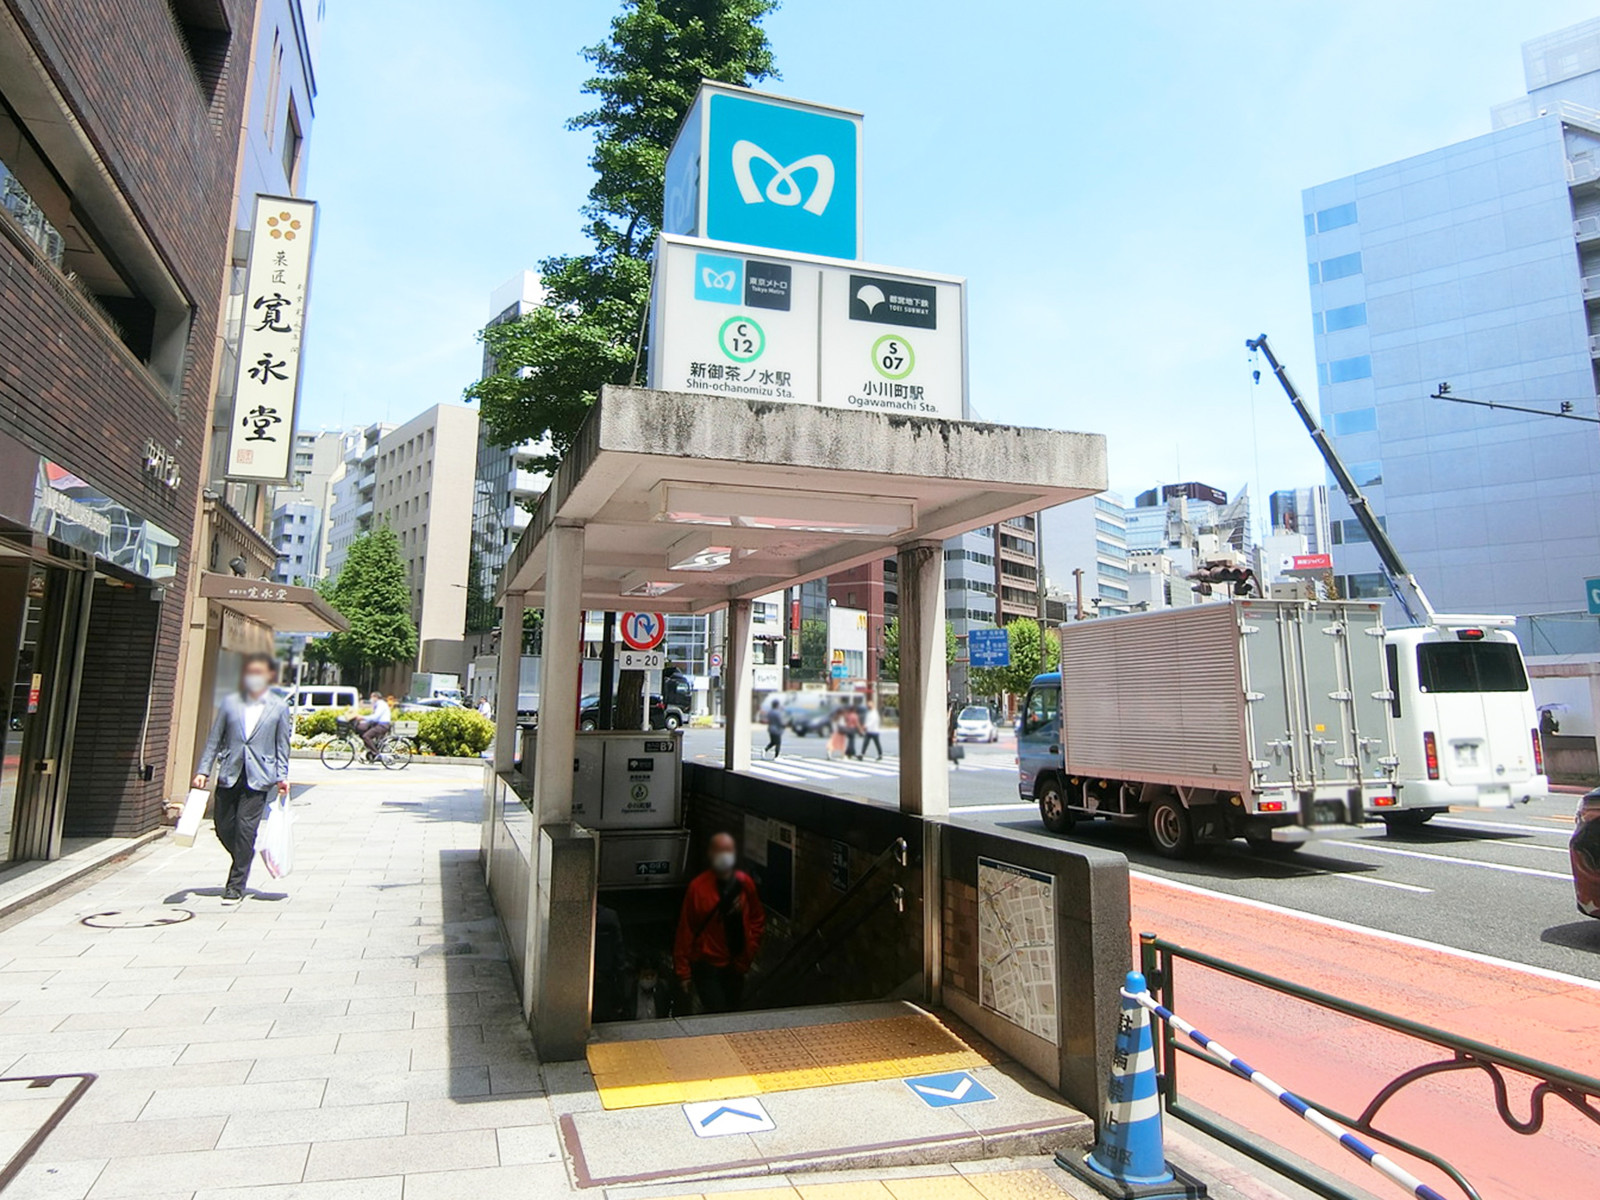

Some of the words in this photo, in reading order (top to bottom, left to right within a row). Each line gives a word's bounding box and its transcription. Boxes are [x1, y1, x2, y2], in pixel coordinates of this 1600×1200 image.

[749, 276, 788, 289] 東京メトロ
[752, 285, 768, 294] Tokyo
[768, 287, 786, 296] Metro
[888, 294, 929, 309] 都営地下鉄
[888, 304, 903, 312] TOEI
[904, 306, 929, 316] SUBWAY
[736, 324, 748, 337] C
[732, 338, 754, 354] 12
[889, 341, 898, 355] S
[882, 355, 904, 370] 07
[689, 361, 792, 387] 新御茶ノ水駅
[686, 378, 774, 397] Shin-ochanomizu
[775, 387, 795, 399] Sta.
[862, 380, 925, 401] 小川町駅
[847, 395, 917, 410] Ogawamachi
[919, 401, 939, 413] Sta.
[625, 654, 659, 667] 8-20
[660, 742, 673, 751] B7
